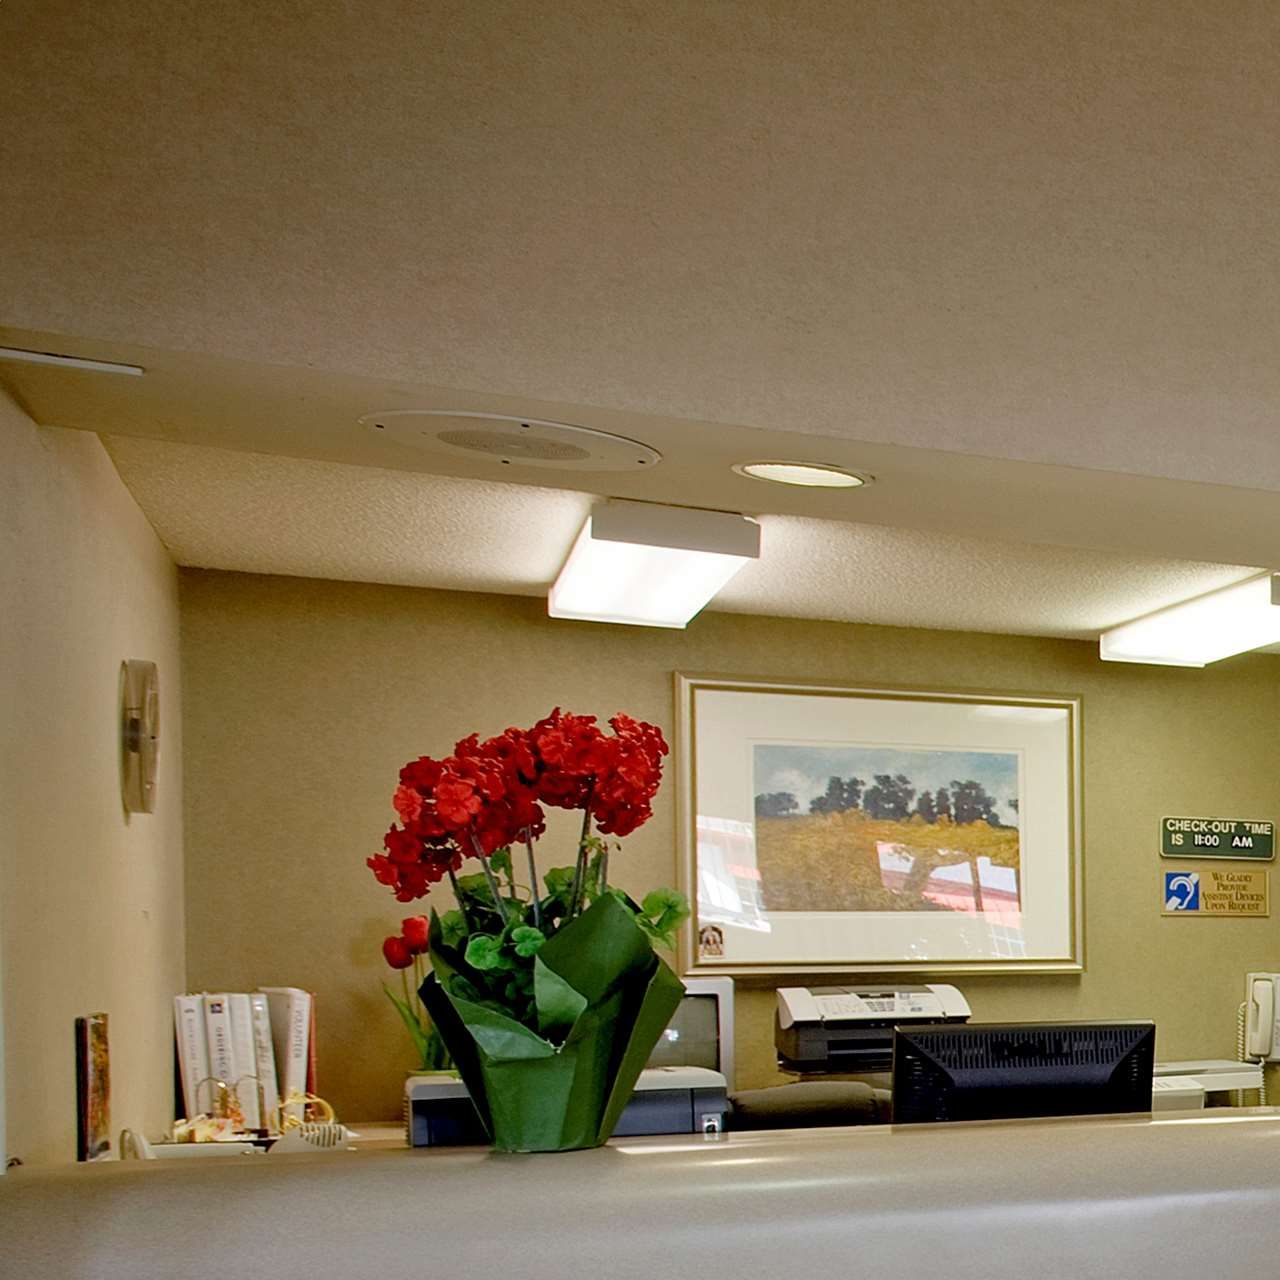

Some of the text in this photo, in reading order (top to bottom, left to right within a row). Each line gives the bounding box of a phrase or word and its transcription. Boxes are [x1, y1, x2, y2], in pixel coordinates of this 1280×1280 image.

[1166, 819, 1272, 835] CHECK-OUT TIME
[1171, 834, 1253, 848] IS 11:00 AM
